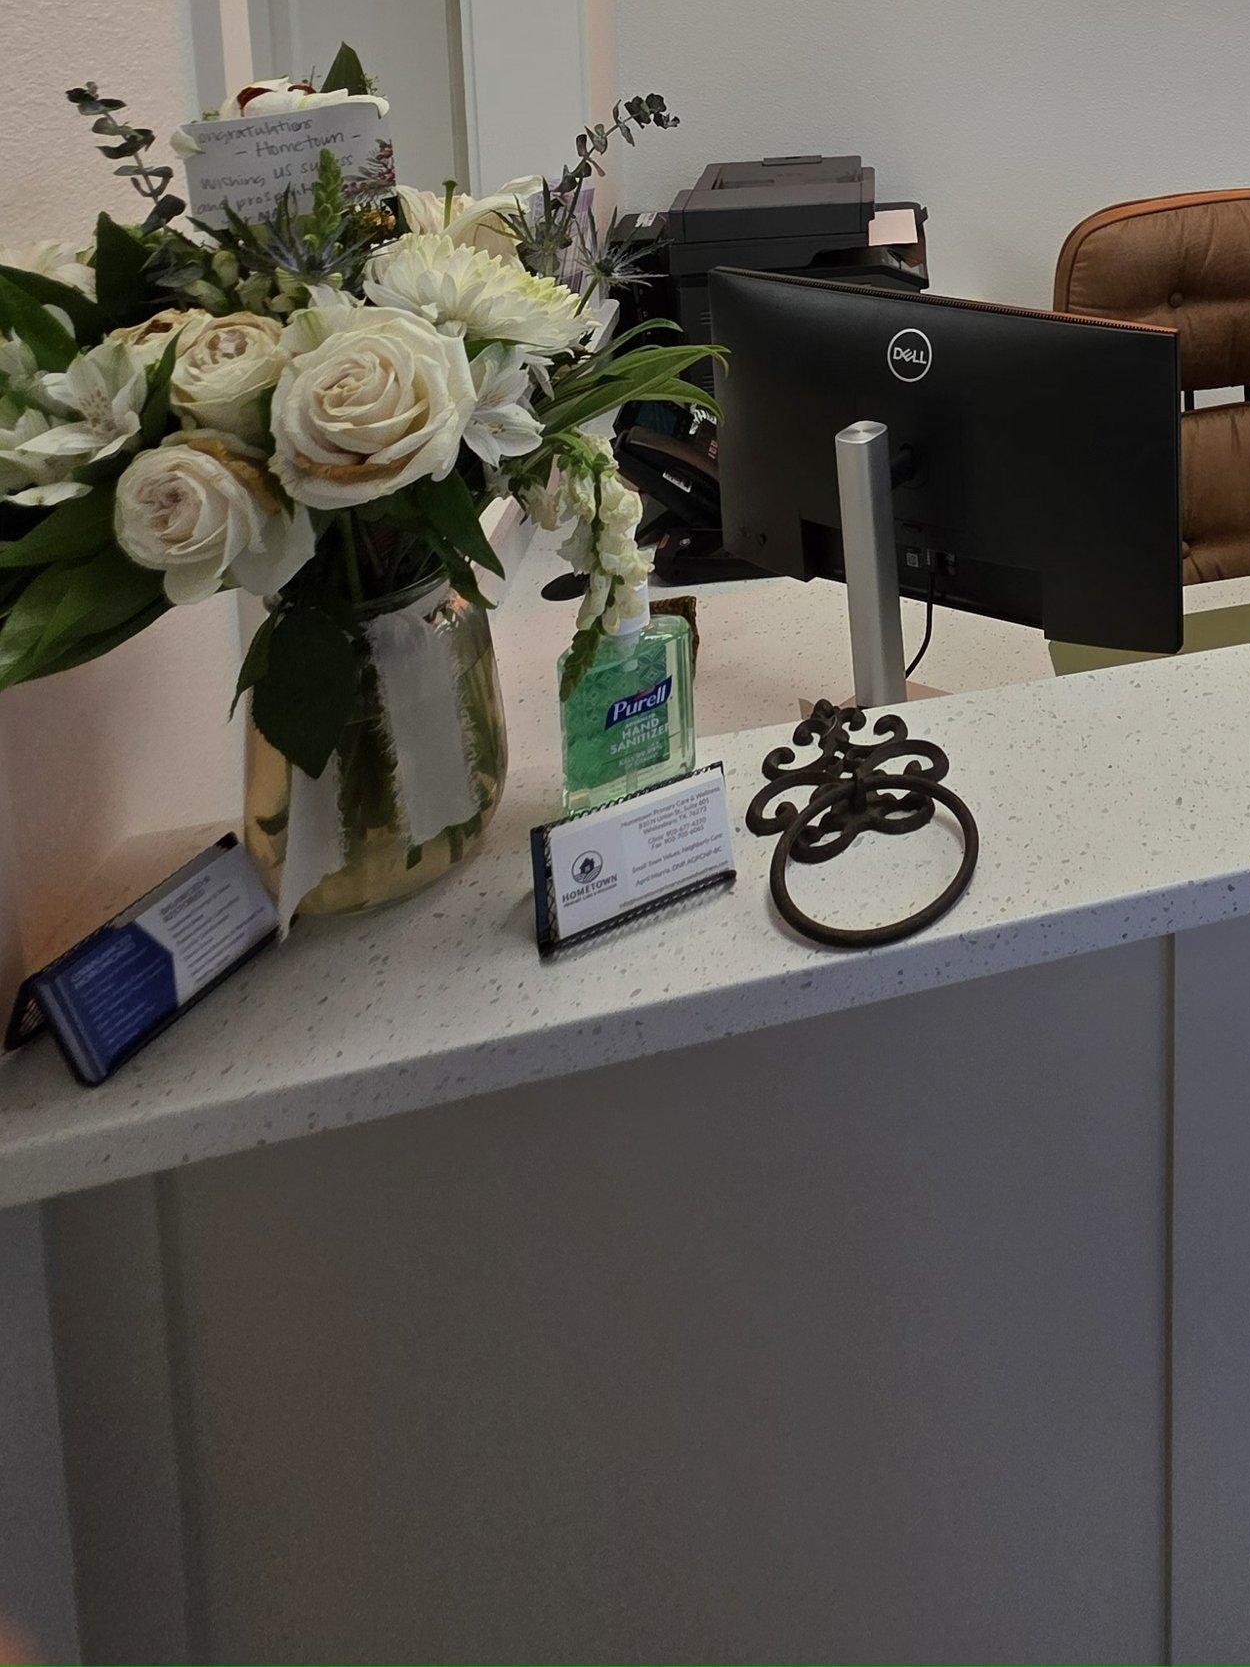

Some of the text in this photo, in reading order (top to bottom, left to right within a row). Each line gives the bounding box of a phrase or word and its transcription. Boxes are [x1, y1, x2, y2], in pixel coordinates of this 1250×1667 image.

[198, 119, 312, 145] ongratulations
[893, 346, 927, 365] DELL
[613, 684, 667, 722] Purell
[622, 718, 660, 740] HAND
[562, 873, 618, 904] HOMETOWN
